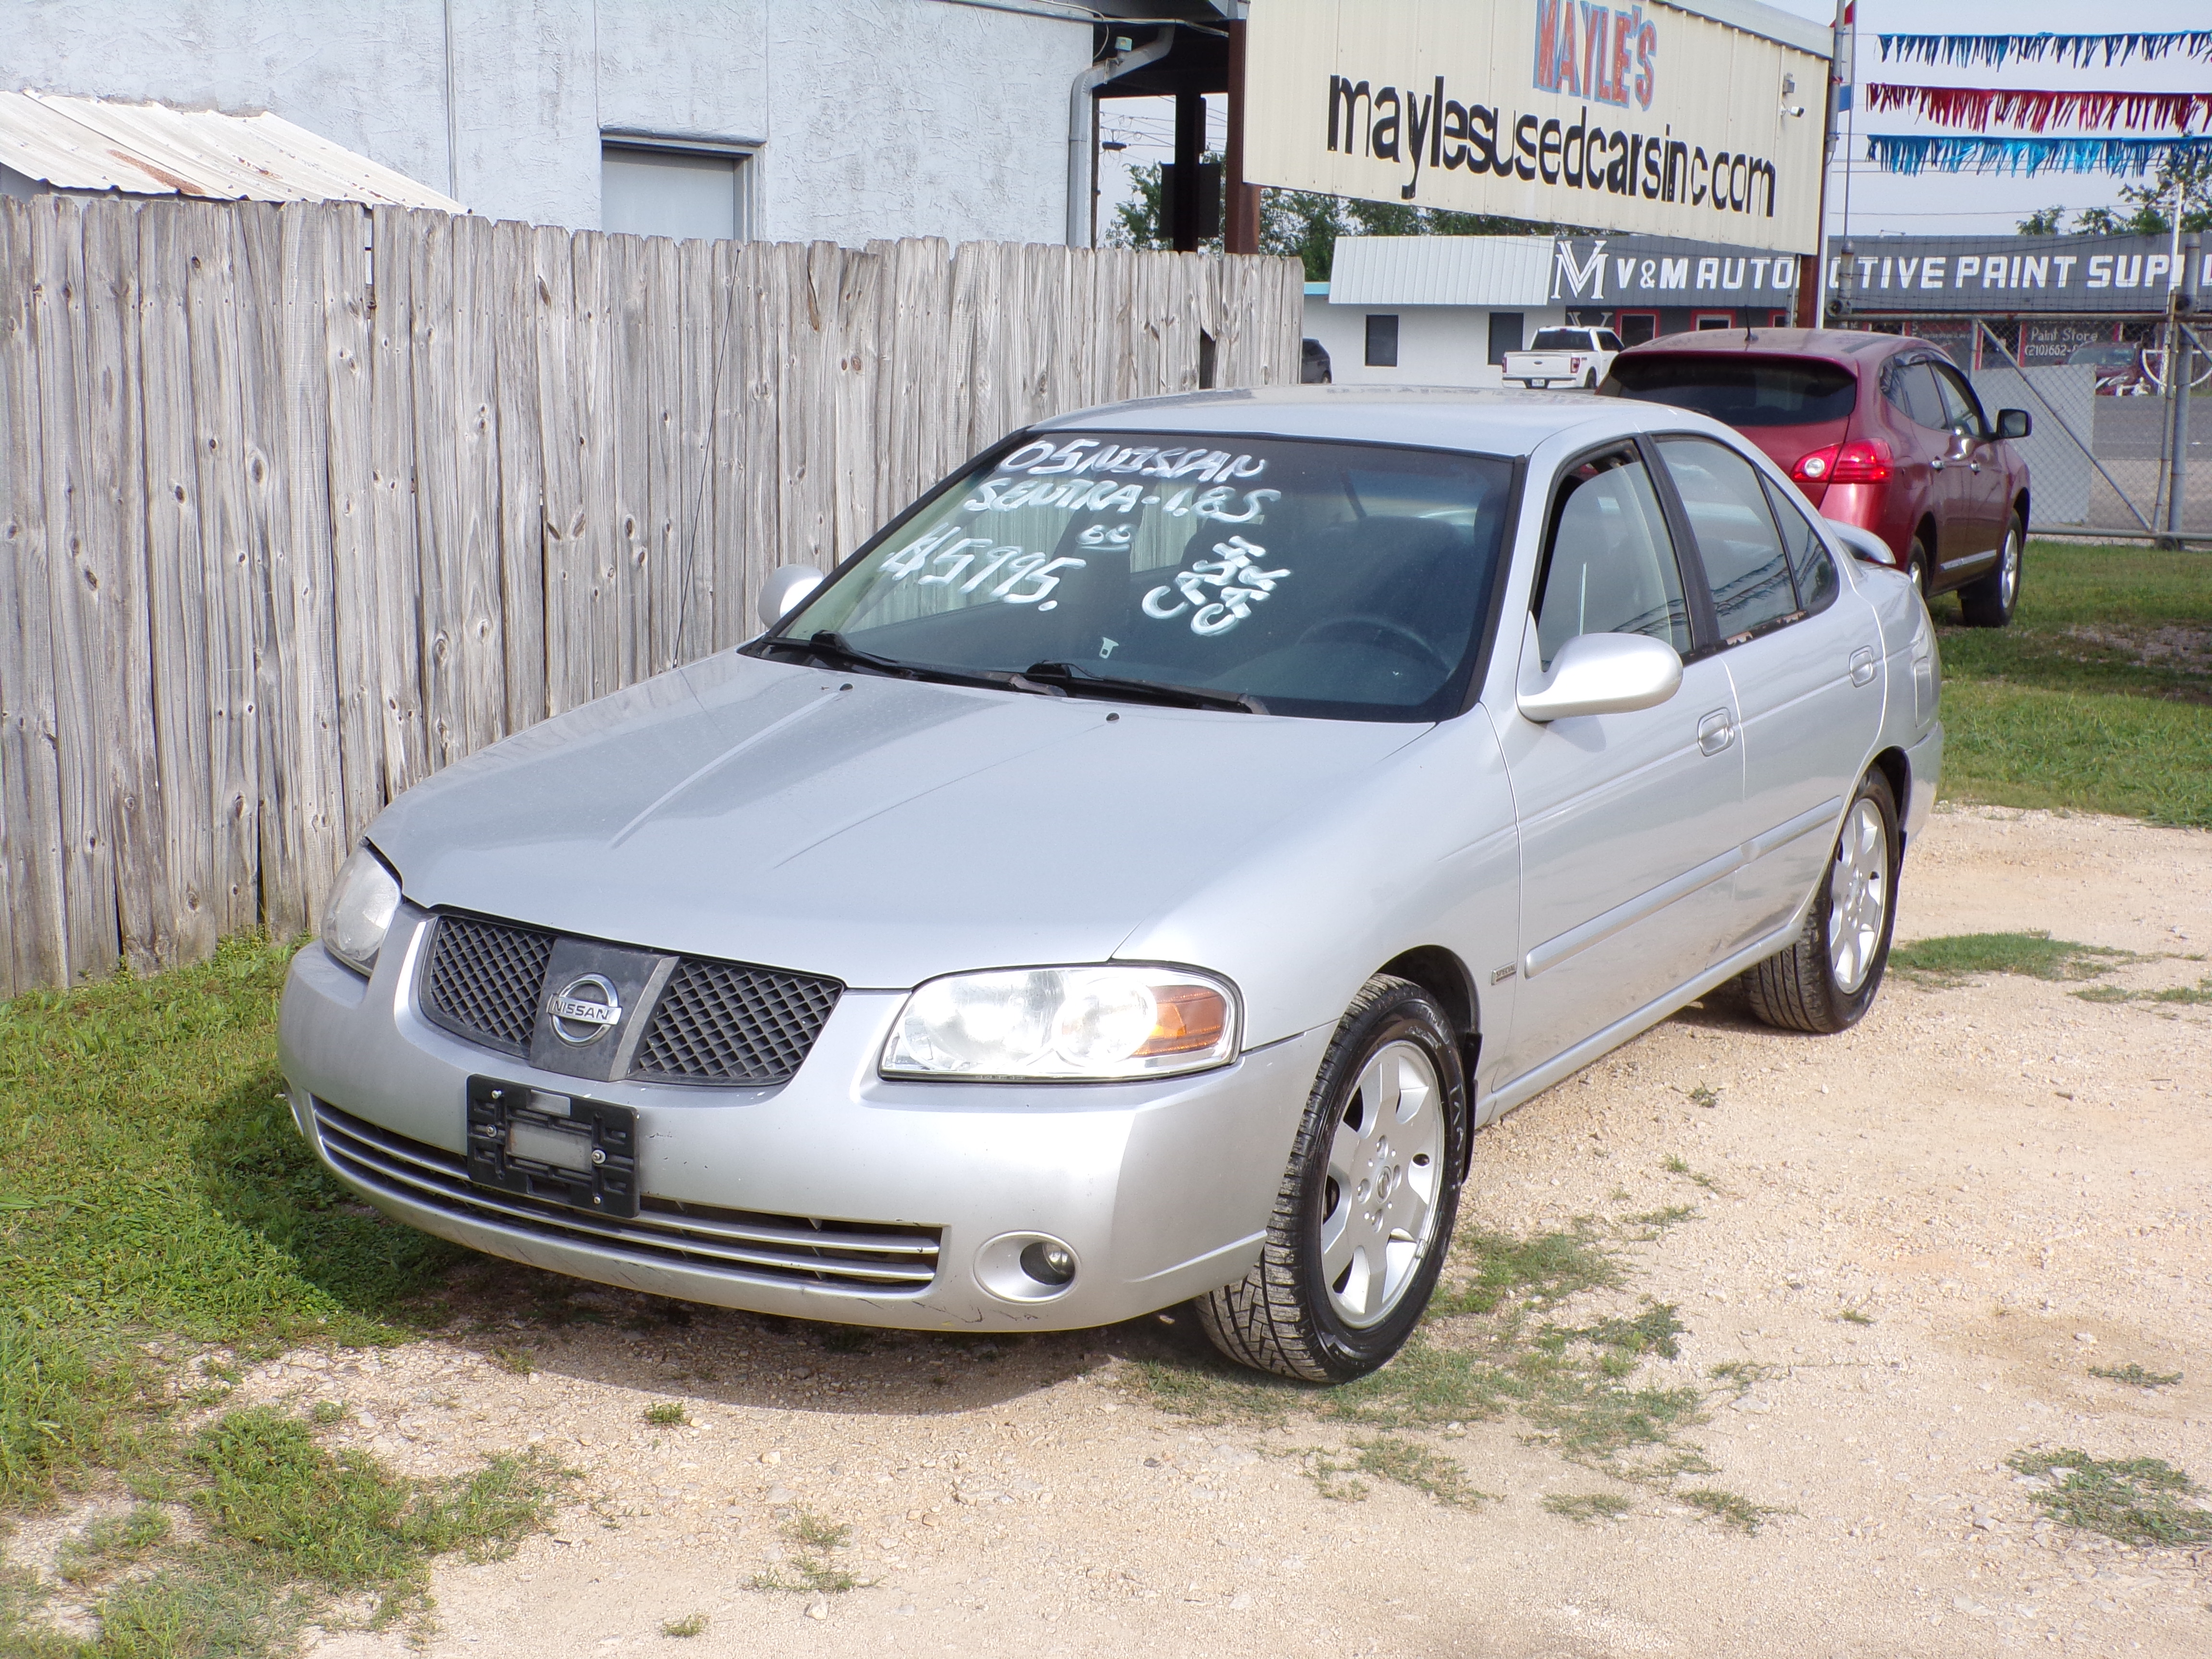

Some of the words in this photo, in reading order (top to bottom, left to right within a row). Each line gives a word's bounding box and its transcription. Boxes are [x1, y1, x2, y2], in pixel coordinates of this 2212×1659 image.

[1533, 0, 1657, 111] MAYLE'S
[1955, 255, 2077, 288] PAINT
[2031, 326, 2058, 342] Paint
[2062, 327, 2099, 342] Store
[1190, 565, 1293, 637] CAR
[553, 1000, 610, 1020] NISSAN
